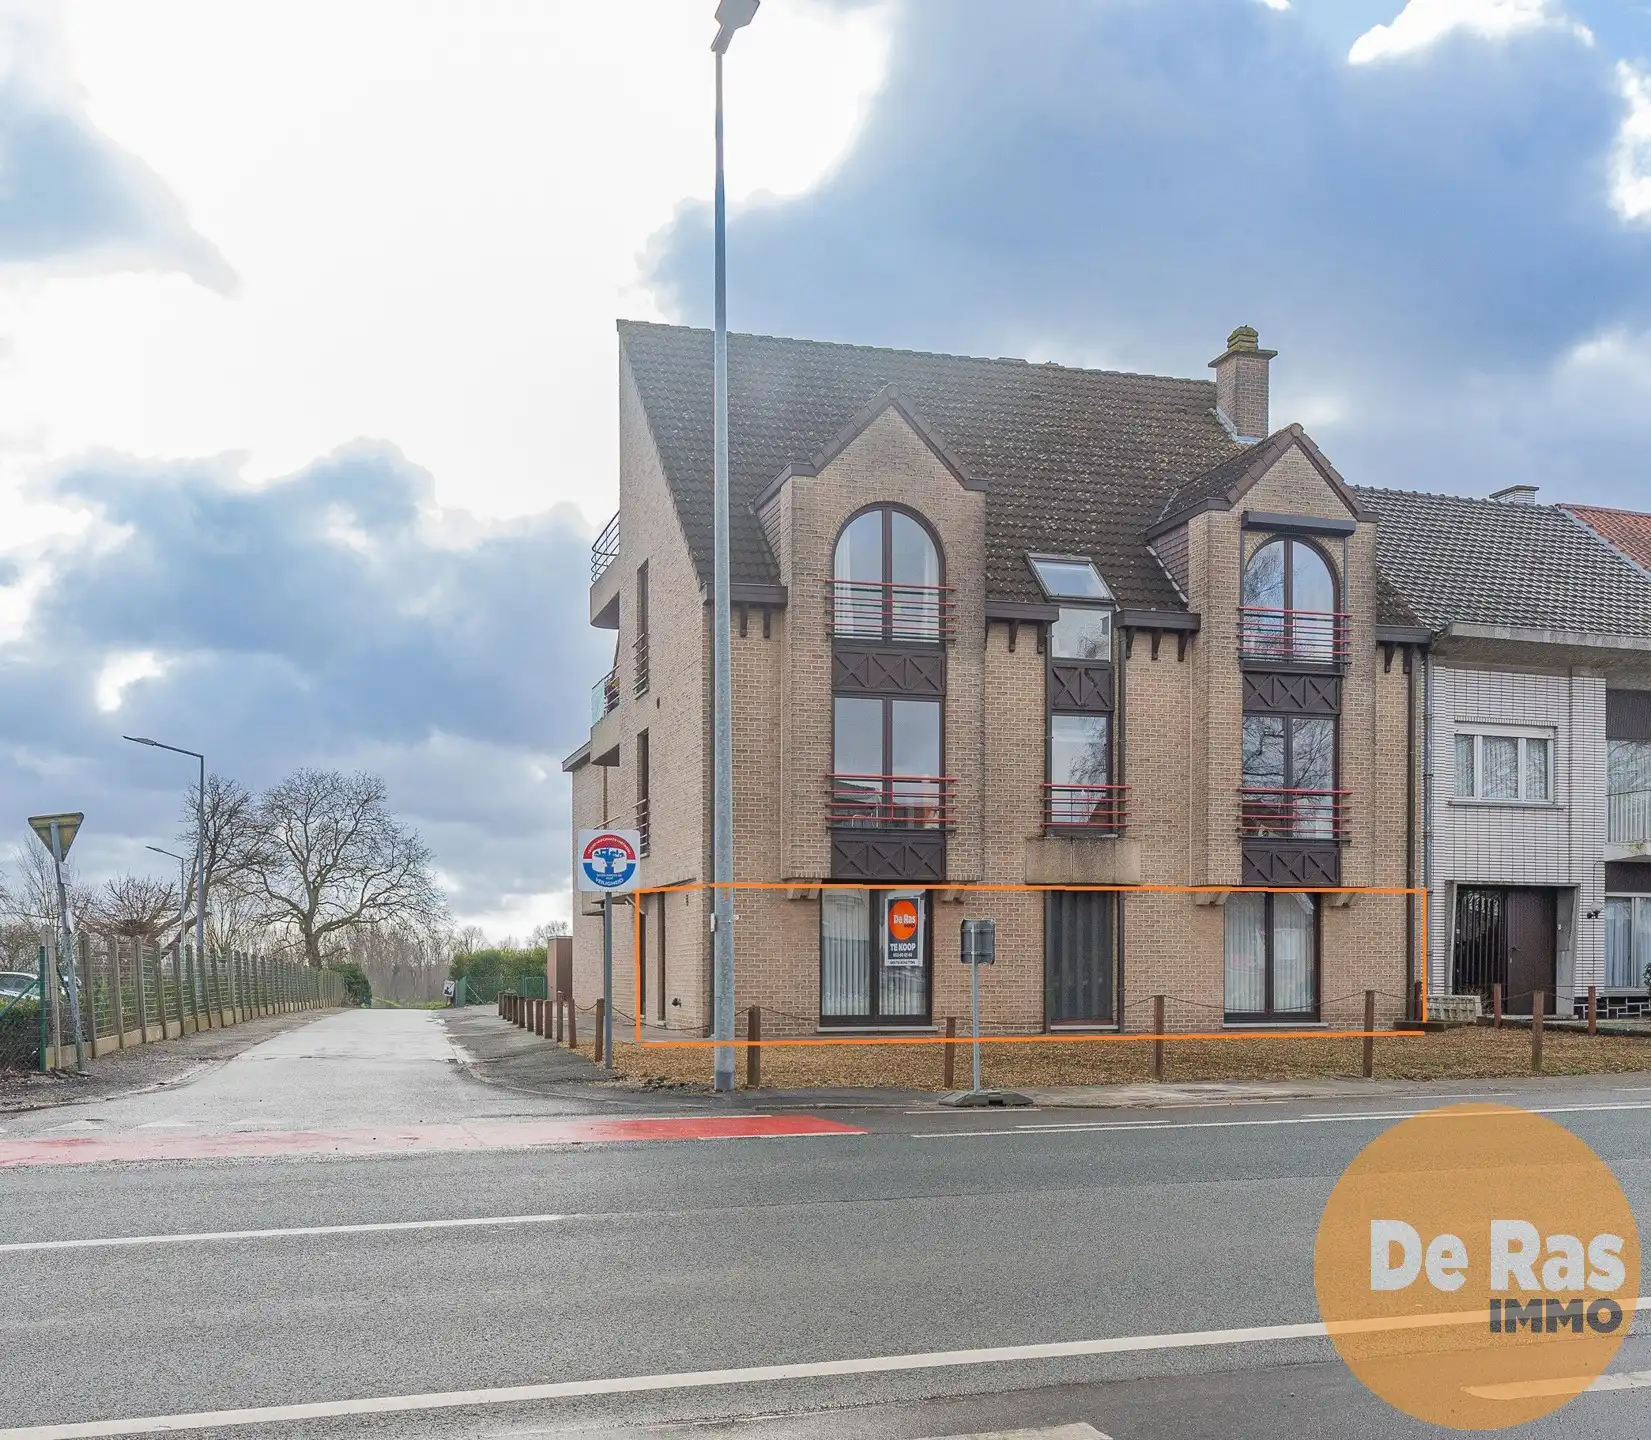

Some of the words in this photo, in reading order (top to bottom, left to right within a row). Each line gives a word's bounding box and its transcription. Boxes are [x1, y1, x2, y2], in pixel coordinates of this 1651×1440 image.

[595, 878, 624, 886] VEILIGHEID
[893, 914, 903, 923] De
[903, 913, 916, 923] Ras
[890, 943, 898, 951] TE
[898, 943, 916, 951] KOOP
